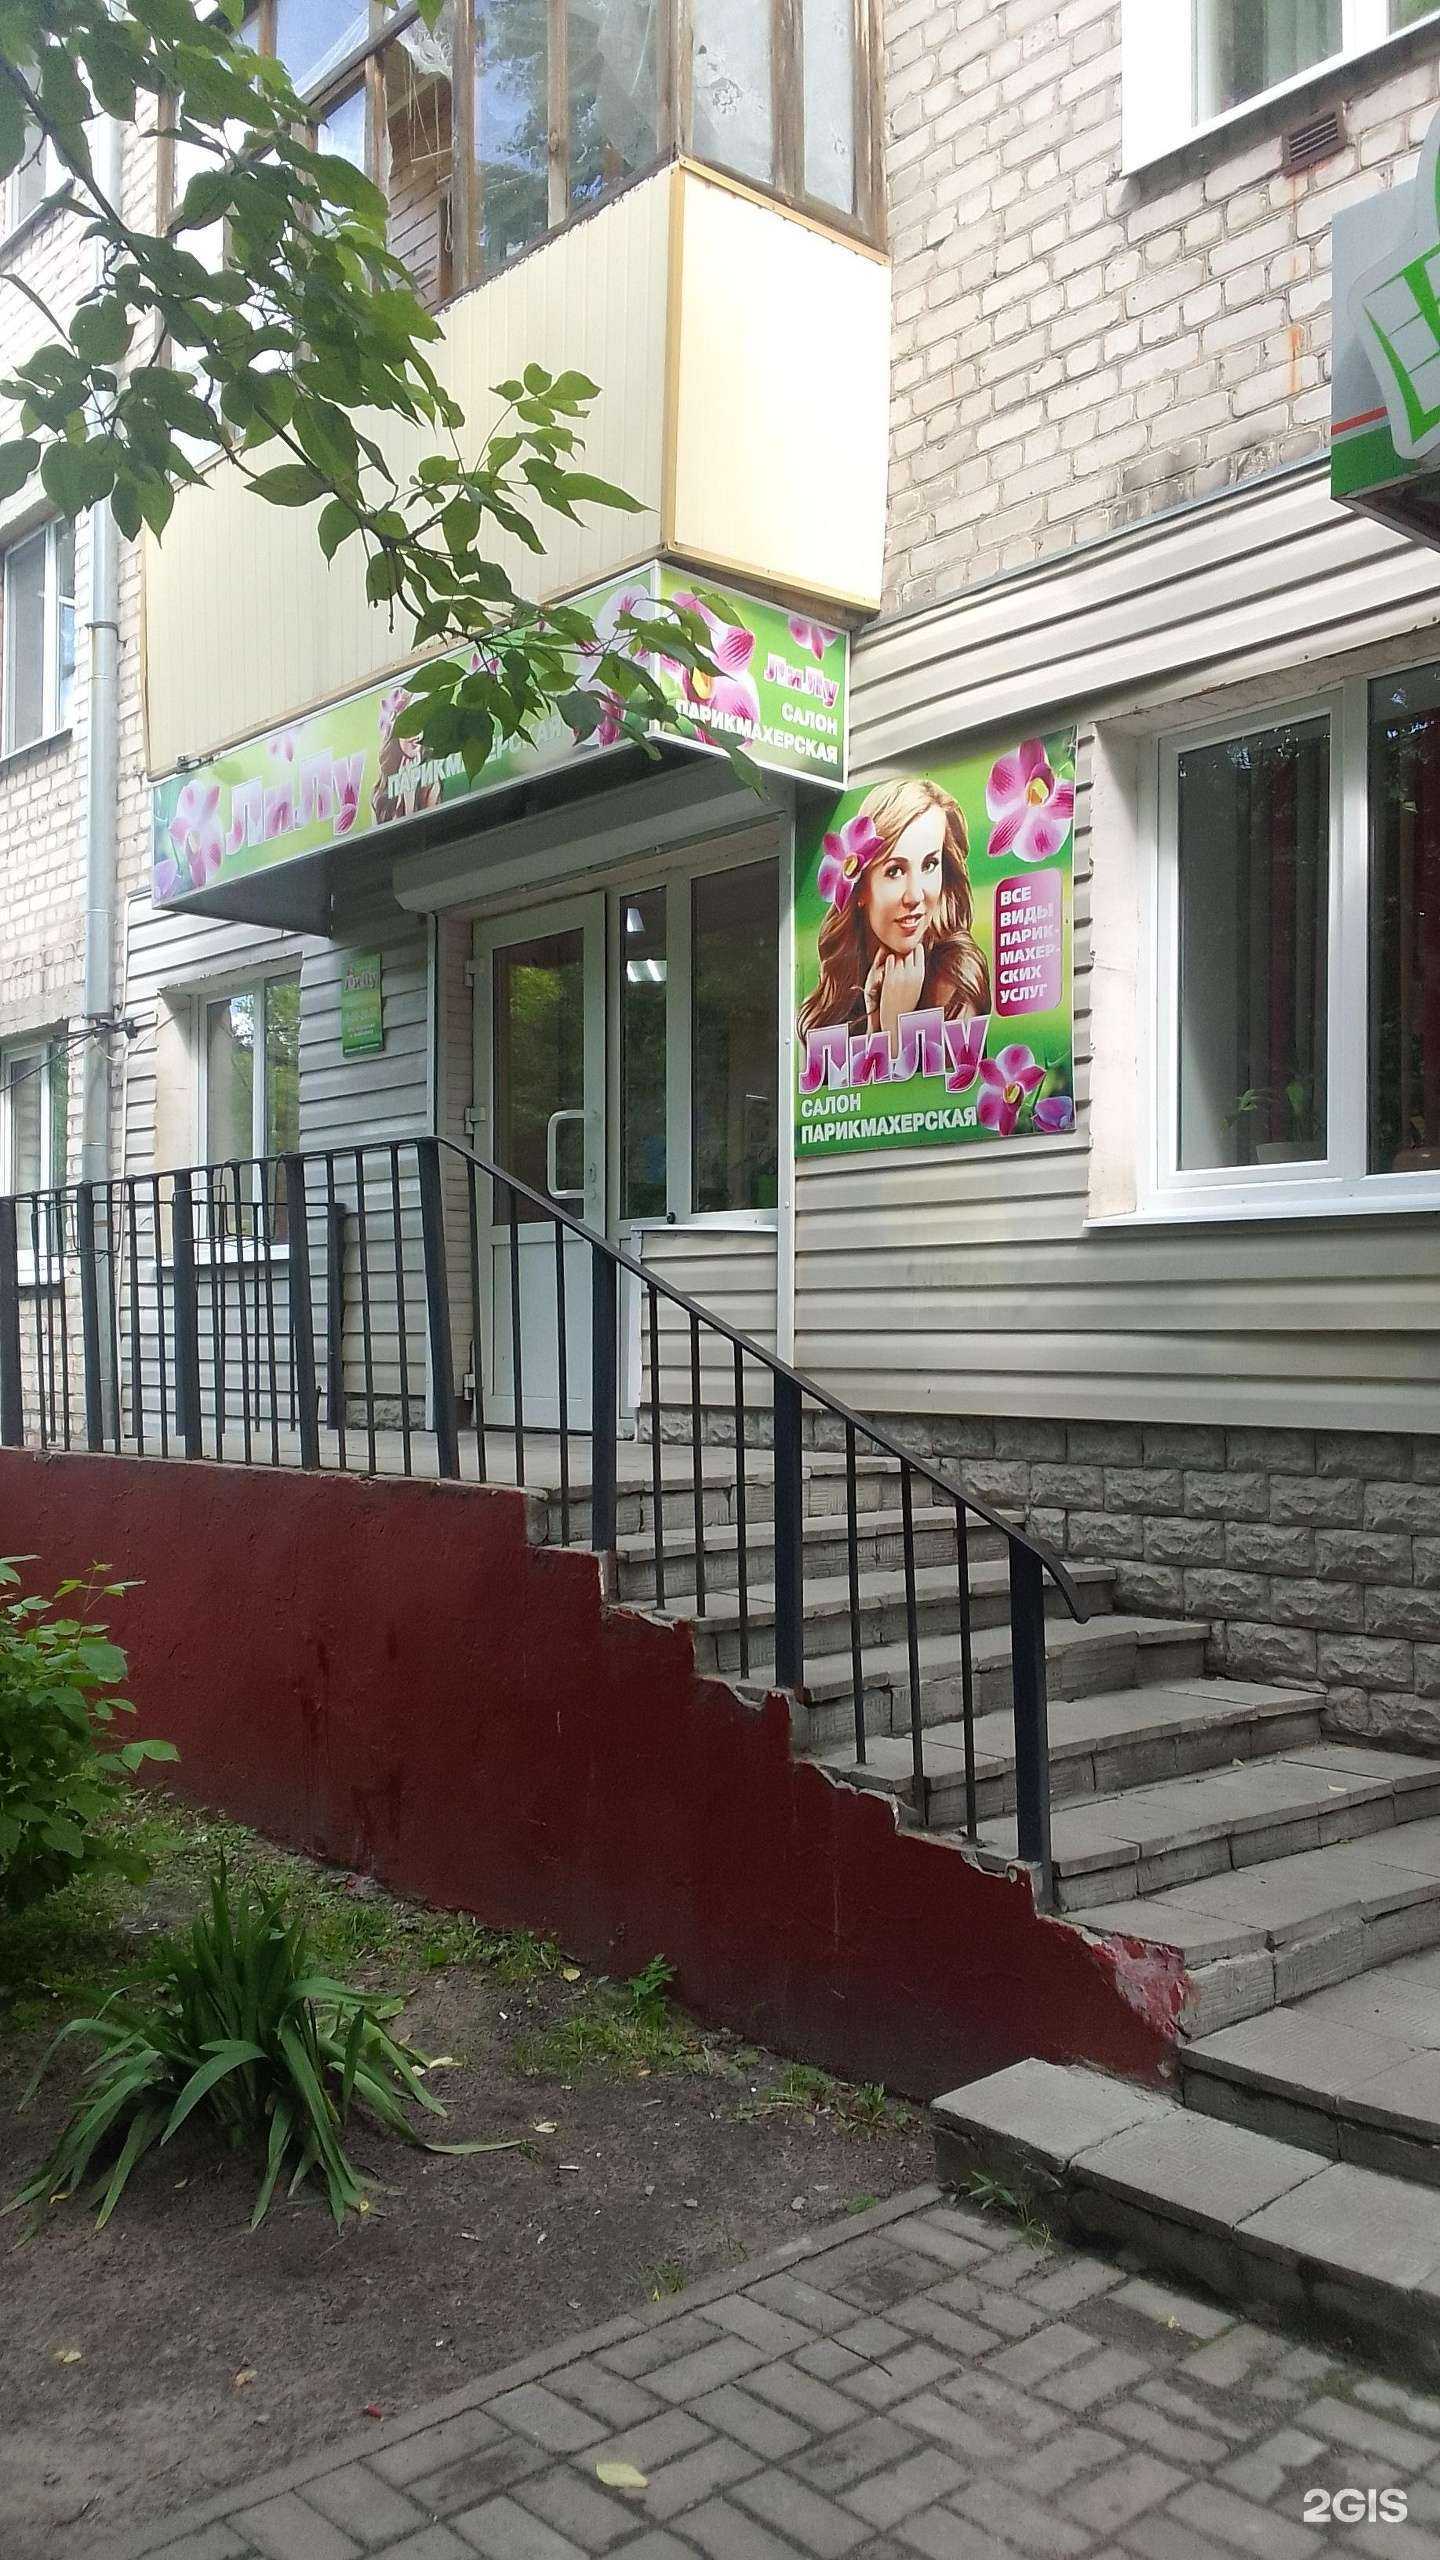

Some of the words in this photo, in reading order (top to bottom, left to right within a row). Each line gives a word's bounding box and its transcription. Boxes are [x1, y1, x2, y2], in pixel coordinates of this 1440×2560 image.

[782, 703, 837, 736] САЛОН
[676, 699, 838, 764] ПАРИКМАХЕРСКАЯ
[1000, 886, 1032, 906] ВСЕ
[1000, 903, 1054, 927] ВИДЫ
[1000, 925, 1059, 947] ПАРИК-
[1000, 943, 1060, 966] МАХЕР-
[1000, 965, 1041, 984] СКИХ
[1000, 983, 1048, 1004] УСЛУГ
[801, 1093, 861, 1118] САЛОН
[801, 1106, 977, 1144] ПАРИКМАХЕРСКАЯ
